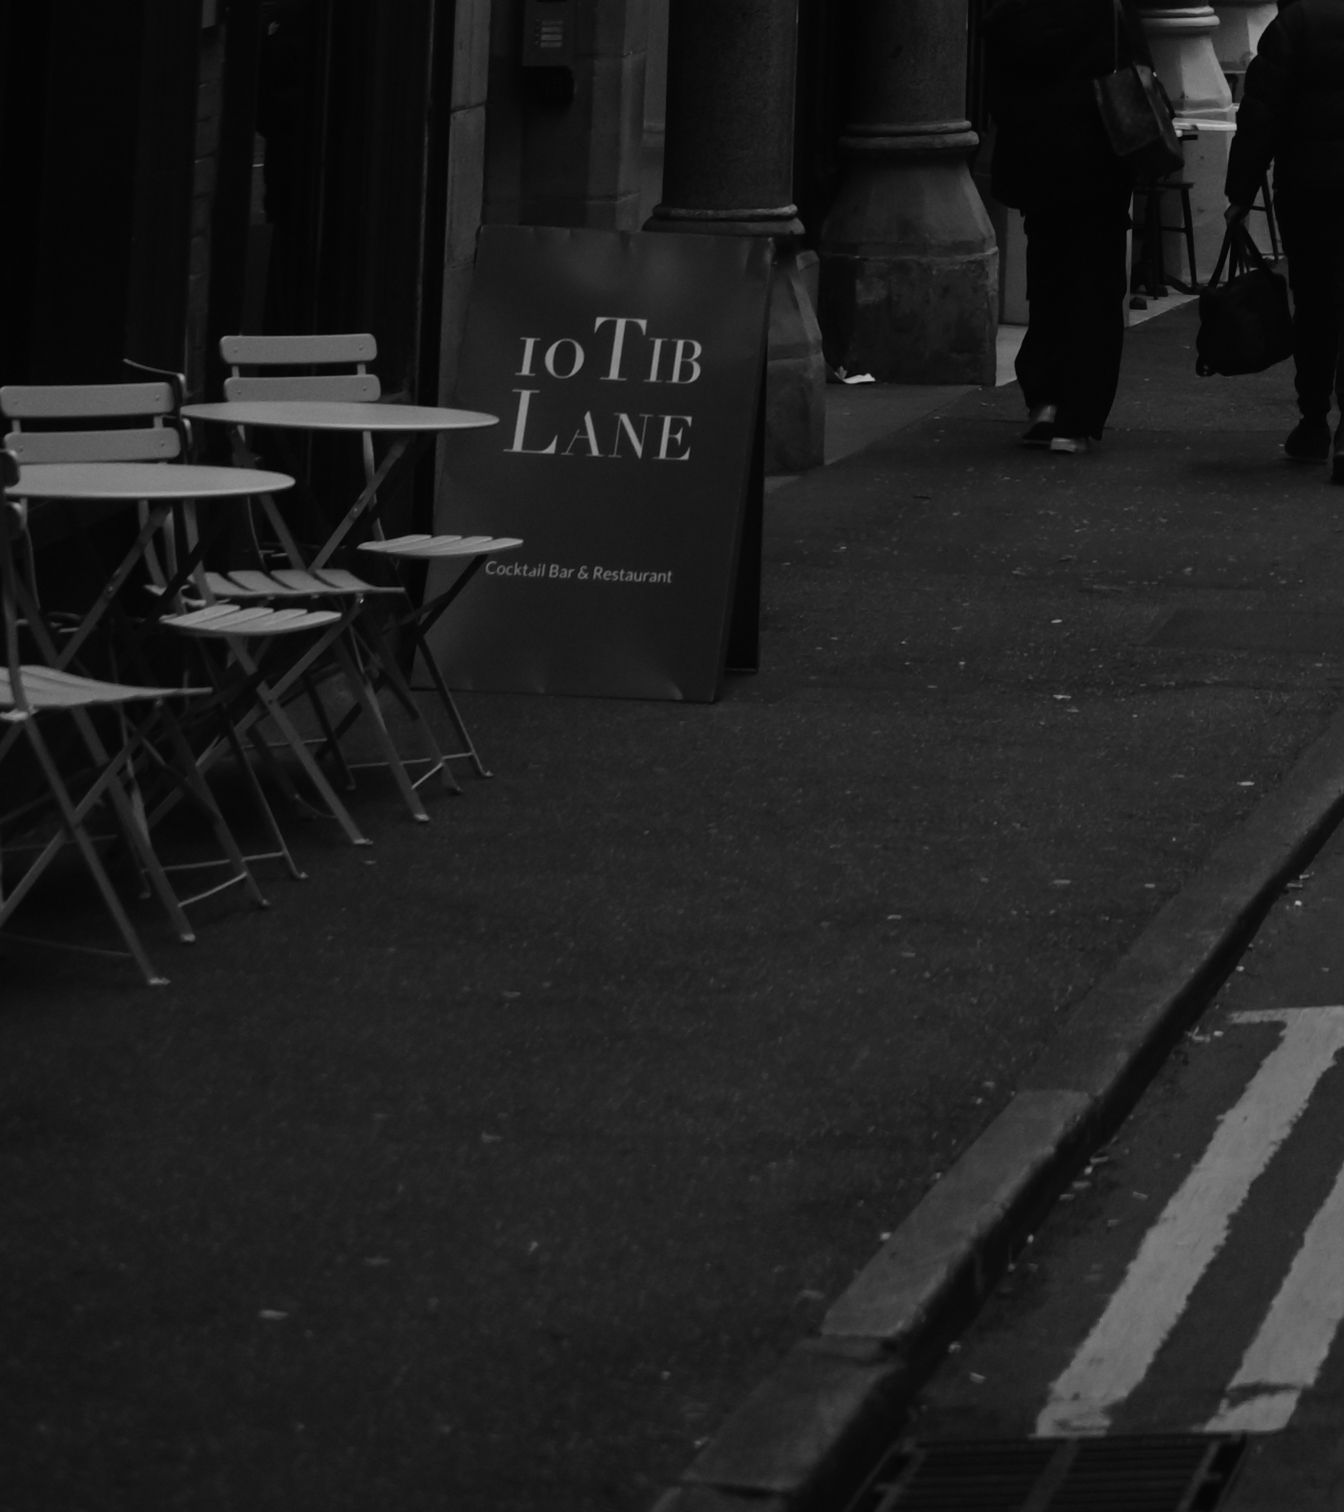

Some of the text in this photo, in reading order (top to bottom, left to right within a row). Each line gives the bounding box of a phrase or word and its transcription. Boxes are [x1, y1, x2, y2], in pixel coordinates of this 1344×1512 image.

[502, 388, 693, 461] LANE
[485, 560, 673, 584] Cocktail Bar & Restaurant
